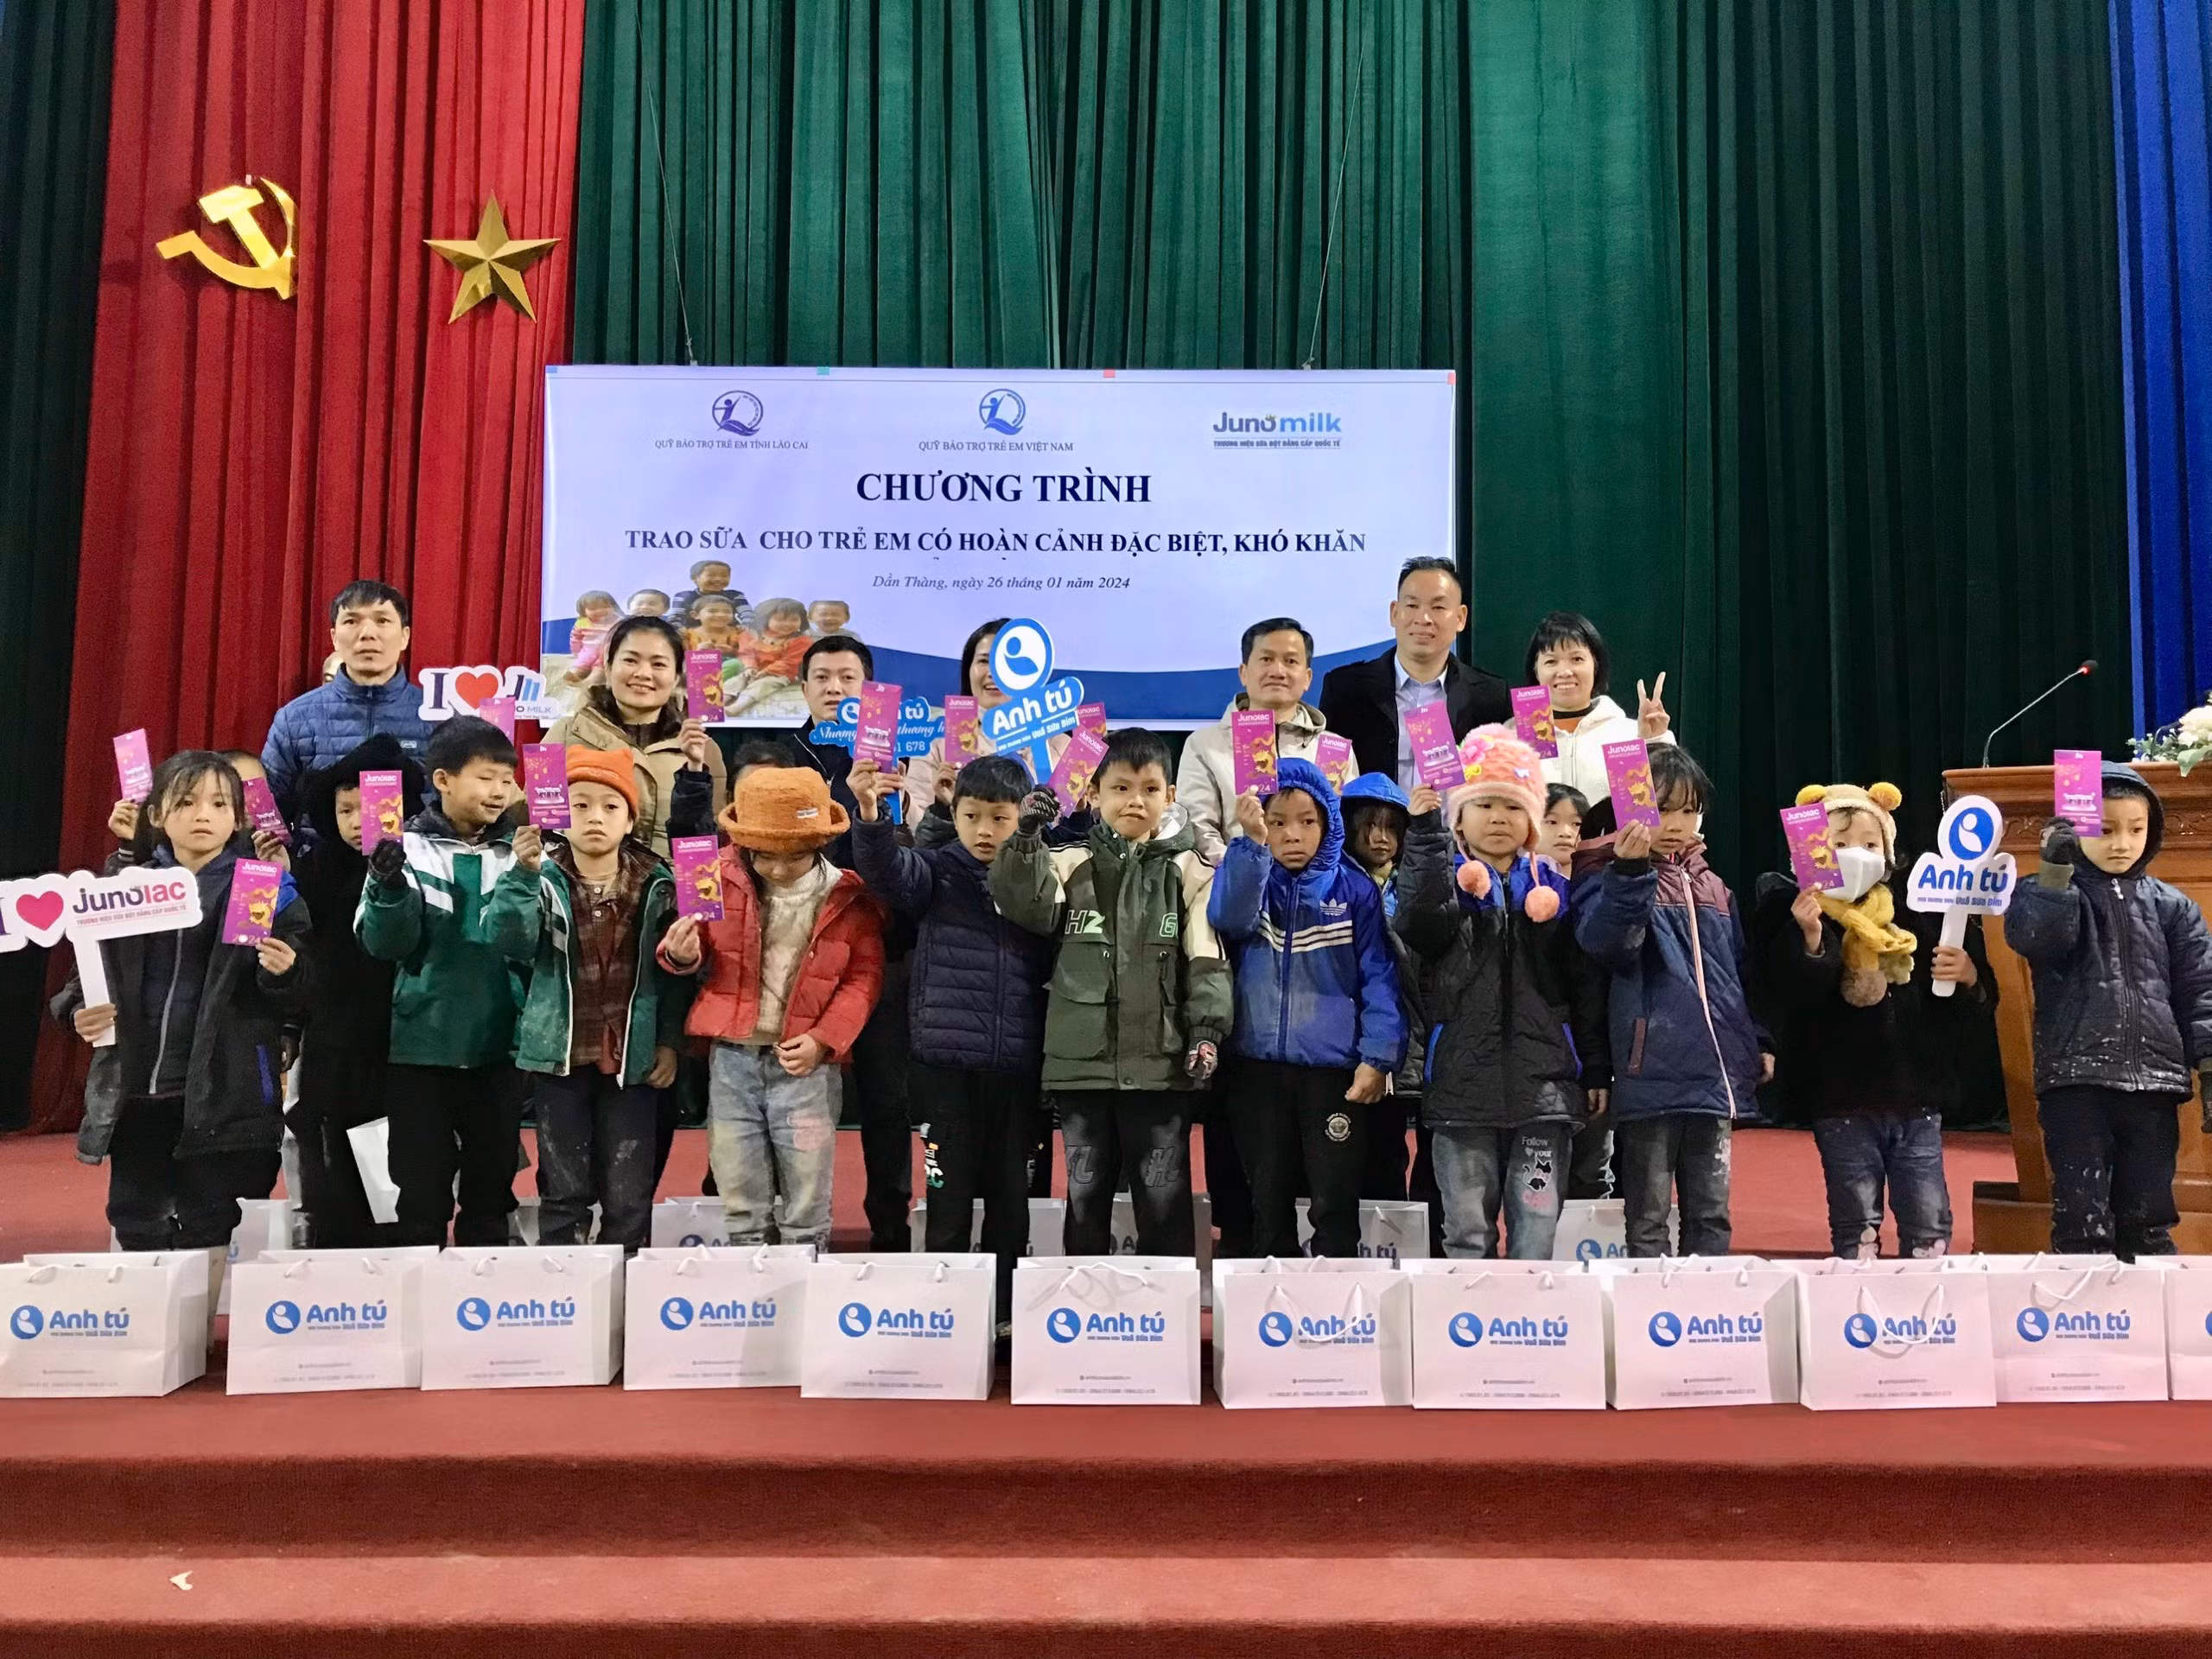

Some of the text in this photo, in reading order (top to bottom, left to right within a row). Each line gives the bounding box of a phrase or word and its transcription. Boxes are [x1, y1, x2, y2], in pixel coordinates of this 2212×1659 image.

[654, 438, 674, 449] QUỸ
[676, 438, 695, 448] BẢO
[696, 440, 714, 449] TRỢ
[715, 439, 733, 448] TRẺ
[749, 439, 771, 449] TỈNH
[772, 439, 791, 449] LÀO
[918, 439, 1073, 452] QUỸ BẢO TRỢ TRẺ EM VIỆT NAM
[857, 467, 1152, 503] CHƯƠNG TRÌNH
[626, 526, 1365, 557] TRAO SỮA CHO TRẺ EM CÓ HOÀN CẢNH ĐẶC BIỆT, KHÓ KHĂN
[873, 573, 1130, 591] Dần Thàng, ngày 26 tháng 01 năm 2024
[1516, 688, 1545, 698] Junolac
[905, 702, 925, 720] tú
[994, 679, 1072, 735] Anh tú
[1077, 706, 1100, 715] unolac
[1237, 714, 1270, 722] Junolac
[906, 741, 926, 752] 678
[1079, 730, 1103, 752] Junolac
[1322, 736, 1348, 748] Junolac
[1608, 744, 1641, 754] Junolac
[1786, 809, 1820, 821] Junolac
[242, 861, 277, 873] Junolac
[1917, 864, 2009, 893] Anh tú
[1606, 1243, 1628, 1258] An
[49, 1306, 130, 1329] Anh tú
[307, 1299, 387, 1323] Anh tú
[496, 1296, 575, 1320] Anh tú
[699, 1297, 777, 1319] Anh tú
[877, 1307, 954, 1330] Anh tú
[1086, 1311, 1165, 1333] Anh tú
[1298, 1314, 1346, 1336] Anh
[1488, 1314, 1568, 1338] Anh tú
[1688, 1311, 1763, 1335] Anh tú
[1882, 1315, 1927, 1337] Anh
[2054, 1308, 2130, 1332] Anh tú
